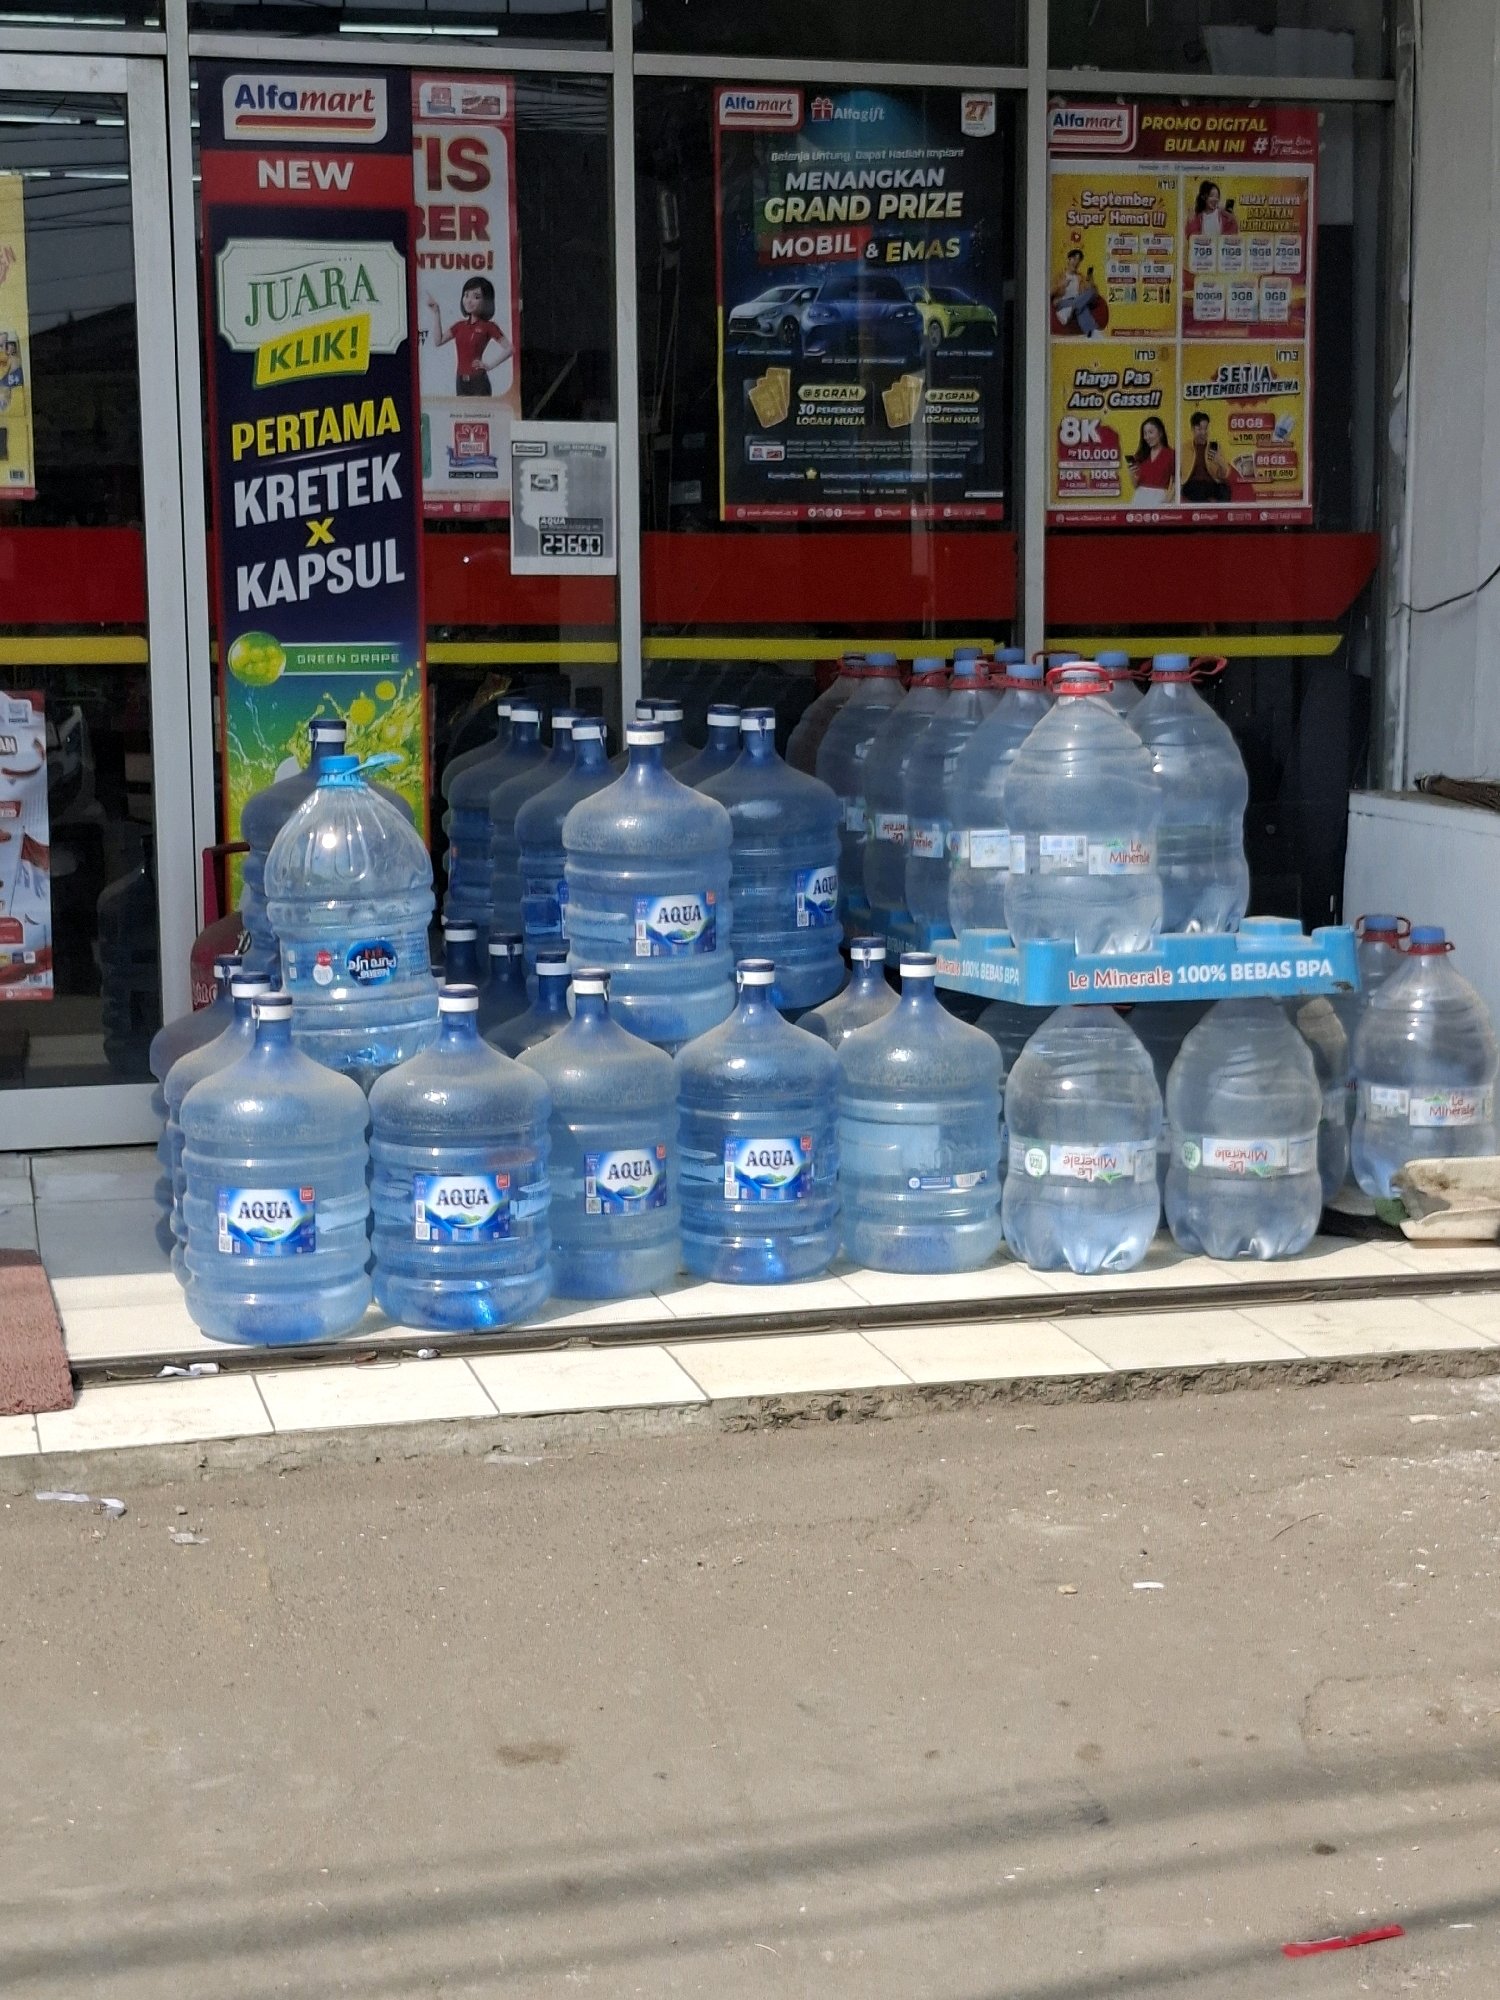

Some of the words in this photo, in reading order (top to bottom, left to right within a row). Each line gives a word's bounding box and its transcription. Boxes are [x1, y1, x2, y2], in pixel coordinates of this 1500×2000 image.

[234, 83, 376, 113] Alfamart
[725, 96, 793, 113] Alfamart
[834, 107, 885, 122] Alfagift
[1052, 114, 1122, 129] Alfamart
[1142, 116, 1201, 131] PROMO
[1205, 117, 1268, 132] DIGITAL
[1164, 138, 1220, 153] BULAN
[1223, 140, 1246, 153] INI
[413, 136, 491, 192] IS
[258, 159, 354, 191] NEW
[785, 167, 945, 191] MENANGKAN
[764, 195, 871, 224] GRAND
[878, 192, 964, 220] PRIZE
[1082, 191, 1156, 211] September
[1067, 211, 1106, 228] Super
[1109, 210, 1150, 226] Hemat
[771, 234, 857, 260] MOBIL
[866, 243, 879, 260] &
[885, 238, 961, 263] EMAS
[244, 263, 380, 326] JUARA
[270, 325, 359, 374] KLIK!
[1075, 369, 1118, 388] Harga
[1124, 369, 1152, 386] Pas
[1220, 366, 1271, 382] SETIA
[1186, 383, 1248, 397] SEPTEMBER
[1250, 380, 1298, 394] ISTIMEWA
[798, 404, 816, 415] 30
[1069, 393, 1104, 408] Auto
[232, 397, 400, 462] PERTAMA
[1060, 416, 1102, 447] 8K
[234, 452, 403, 528] KRETEK
[540, 516, 566, 526] AQUA
[237, 538, 405, 612] KAPSUL
[297, 653, 346, 665] GREEN
[350, 653, 400, 664] GRAPE
[1130, 839, 1142, 852] Le
[1109, 851, 1150, 864] Minerale
[657, 904, 702, 925] AQUA
[962, 959, 980, 978] 100%
[980, 962, 1004, 982] BEBAS
[1004, 967, 1020, 986] BPA
[1068, 970, 1088, 990] Le
[1093, 966, 1172, 989] Minerale
[1176, 964, 1226, 984] 100%
[1230, 962, 1292, 982] BEBAS
[1294, 958, 1334, 979] BPA
[1452, 1094, 1464, 1106] Le
[1429, 1104, 1474, 1117] Minerale
[606, 1159, 653, 1180] AQUA
[745, 1149, 795, 1170] AQUA
[1063, 1154, 1117, 1169] Minerale
[435, 1188, 490, 1209] AQUA
[238, 1200, 292, 1222] AQUA
